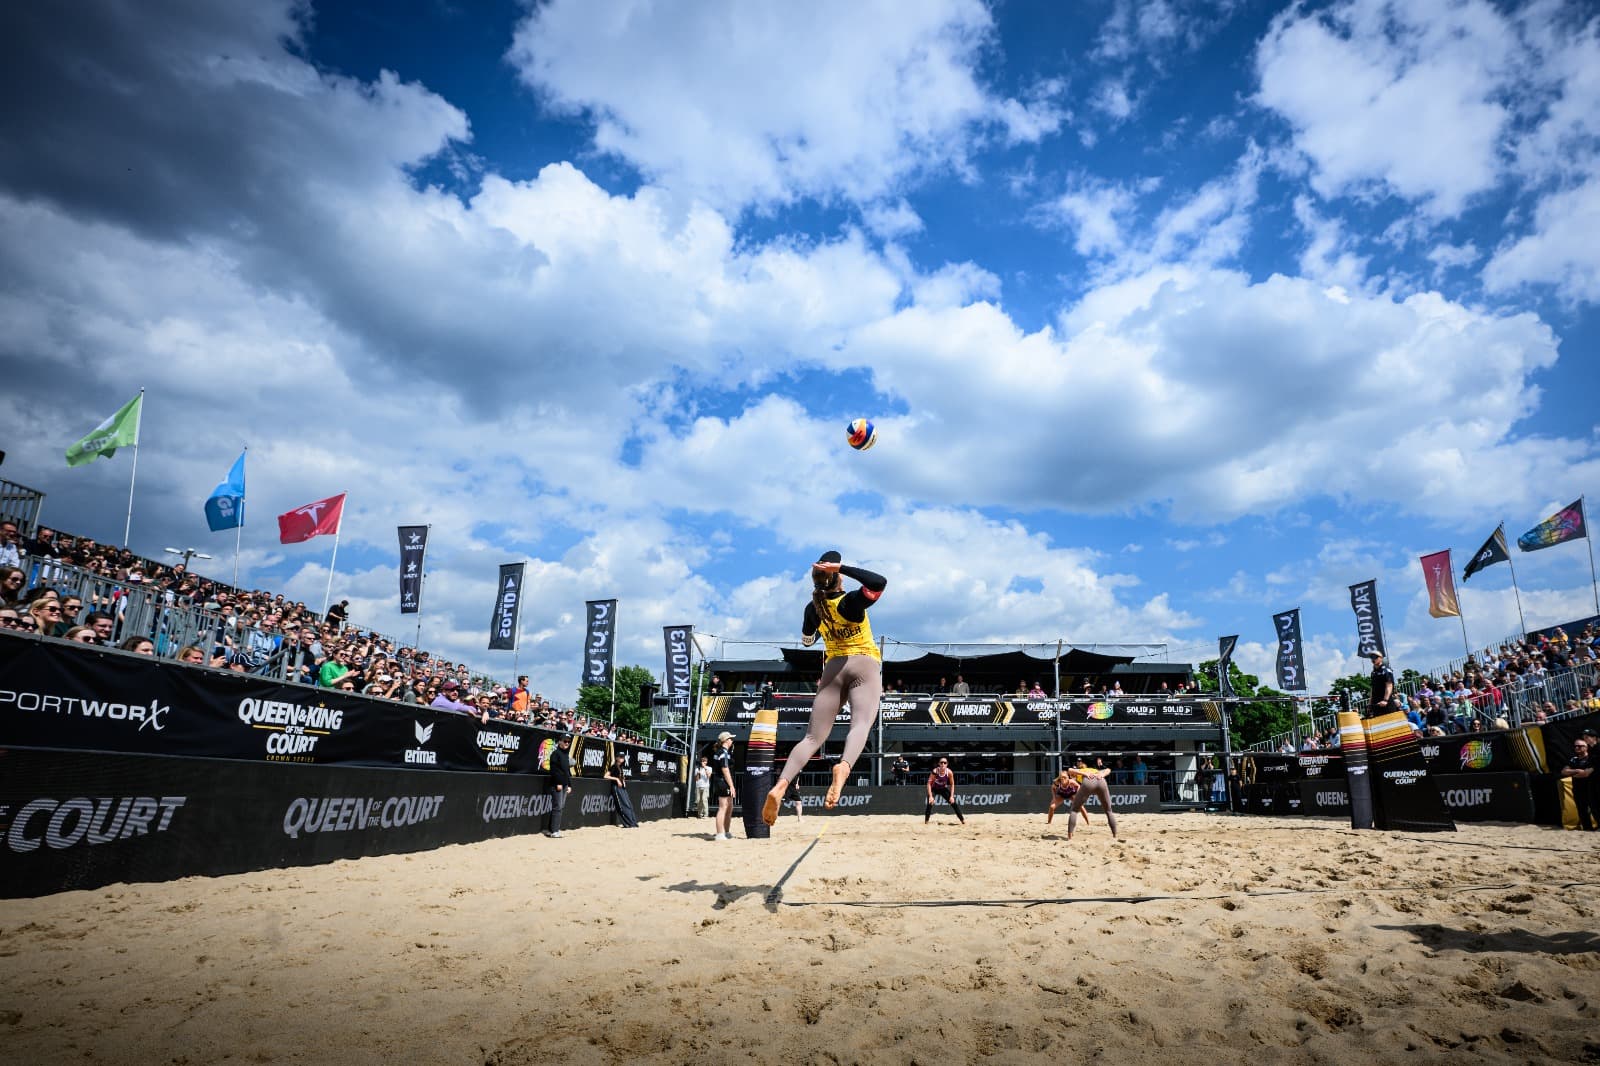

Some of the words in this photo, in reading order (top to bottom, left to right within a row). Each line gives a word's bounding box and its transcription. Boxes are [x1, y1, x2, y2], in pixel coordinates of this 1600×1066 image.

[238, 697, 343, 730] QUEEN&KING
[737, 711, 757, 719] erim
[953, 704, 991, 716] HAMBURG
[266, 733, 318, 755] COURT
[404, 746, 437, 764] erima
[971, 794, 1012, 806] COURT
[1316, 791, 1344, 807] QUEEN
[1446, 788, 1493, 807] COURT
[283, 797, 373, 838] QUEEN
[380, 795, 445, 829] COURT
[482, 795, 524, 823] QUEEN
[7, 796, 187, 852] COURT
